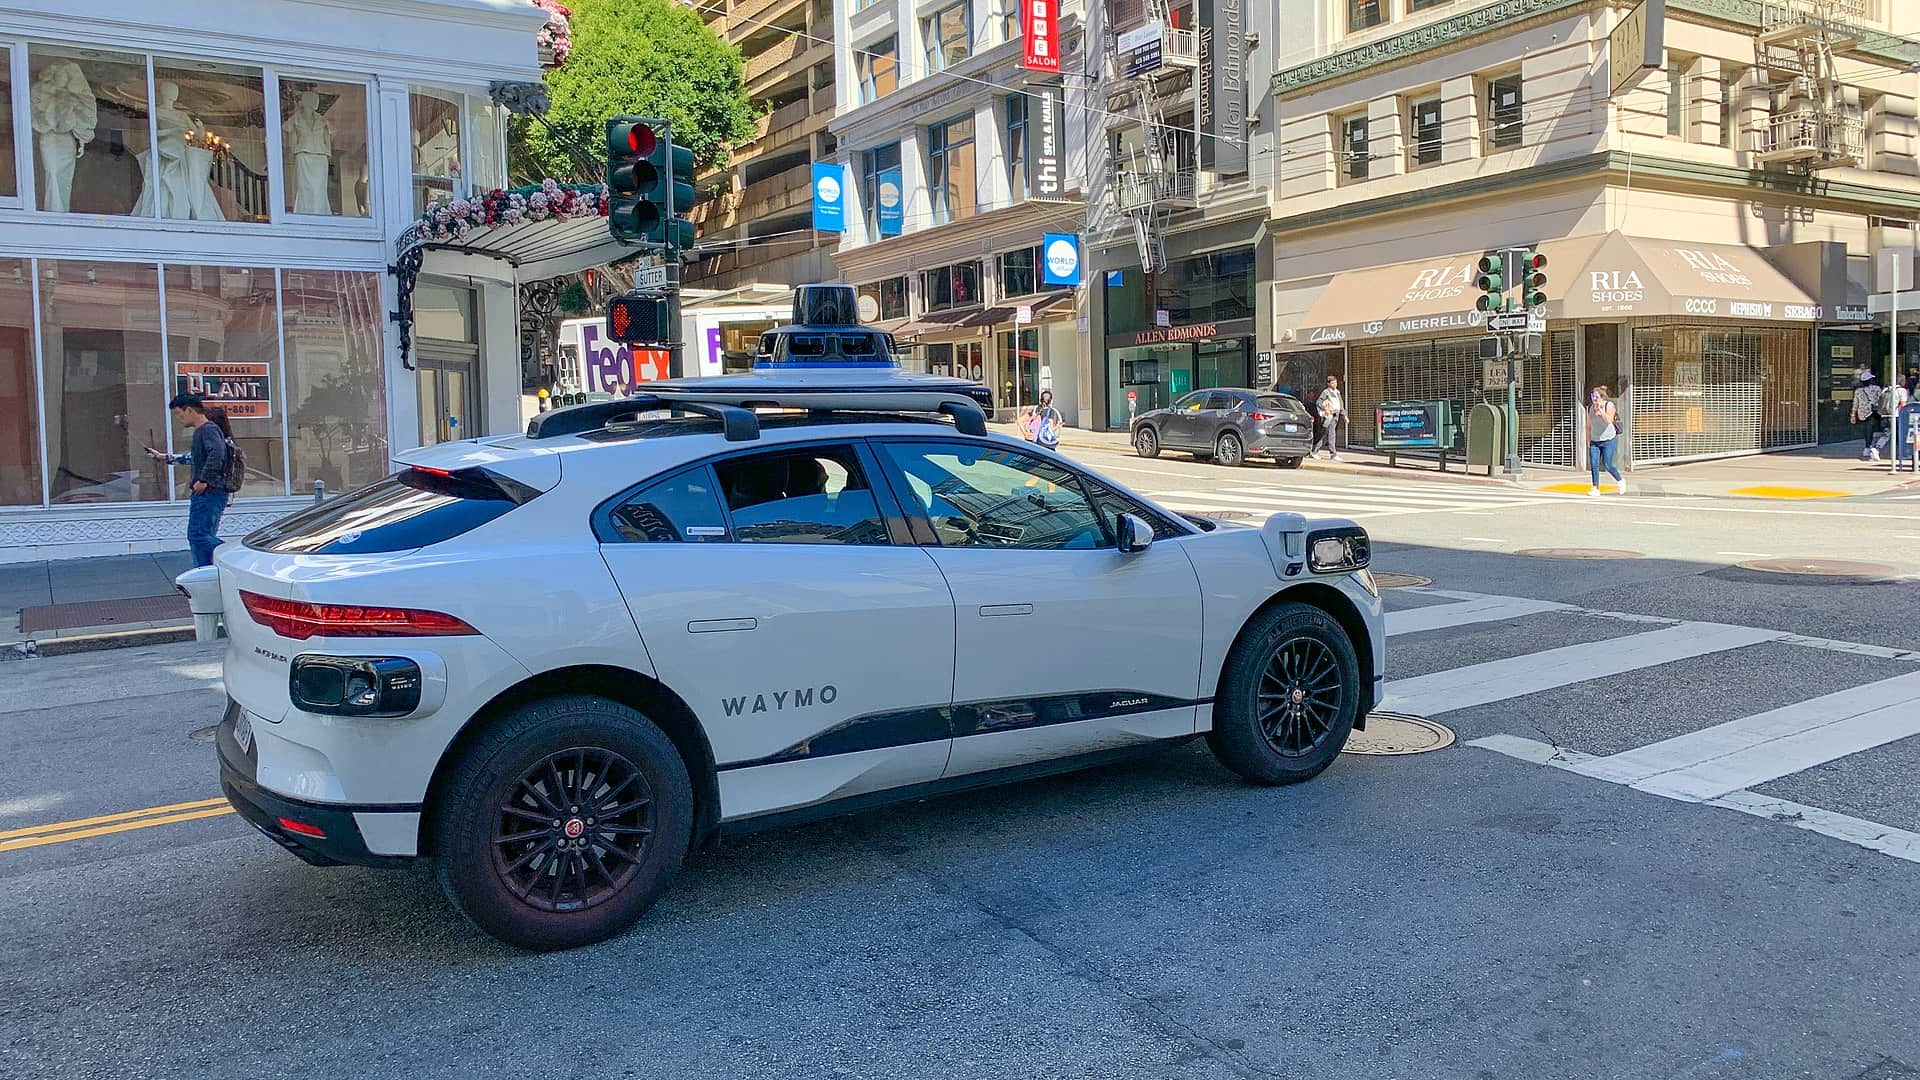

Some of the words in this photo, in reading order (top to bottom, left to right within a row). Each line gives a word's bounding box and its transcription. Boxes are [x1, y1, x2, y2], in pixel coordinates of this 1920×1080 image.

[1200, 26, 1212, 60] Allen
[1220, 0, 1241, 94] Edmonds
[1027, 56, 1057, 67] SALON
[1200, 61, 1213, 126] Edmonds
[1041, 91, 1052, 123] NAILS
[1042, 124, 1052, 134] &
[1221, 100, 1241, 151] Allen
[1043, 135, 1053, 156] SPA
[1038, 158, 1057, 194] thi
[1048, 256, 1076, 265] WORLD
[1674, 248, 1742, 273] RIA
[639, 270, 663, 285] SUTTER
[1408, 263, 1473, 290] RIA
[1590, 270, 1646, 291] RIA
[1700, 271, 1753, 287] SHOES
[1402, 285, 1465, 304] SHOES
[1591, 291, 1644, 302] SHOES
[1685, 298, 1717, 314] ecco
[1730, 302, 1763, 316] MEPHISTO
[1784, 304, 1824, 319] SEBAGO
[1362, 321, 1384, 335] UGG
[1399, 315, 1465, 331] MERRELL
[1135, 329, 1166, 345] ALLEN
[1167, 323, 1217, 341] EDMONDS
[1310, 328, 1346, 343] Clarks
[583, 325, 671, 397] FedEx
[1258, 352, 1270, 361] 310
[203, 366, 221, 374] FOR
[224, 366, 252, 374] LEASE
[186, 372, 260, 398] PLANT
[721, 685, 838, 718] WAYMO
[1109, 697, 1149, 709] JAGUAR
